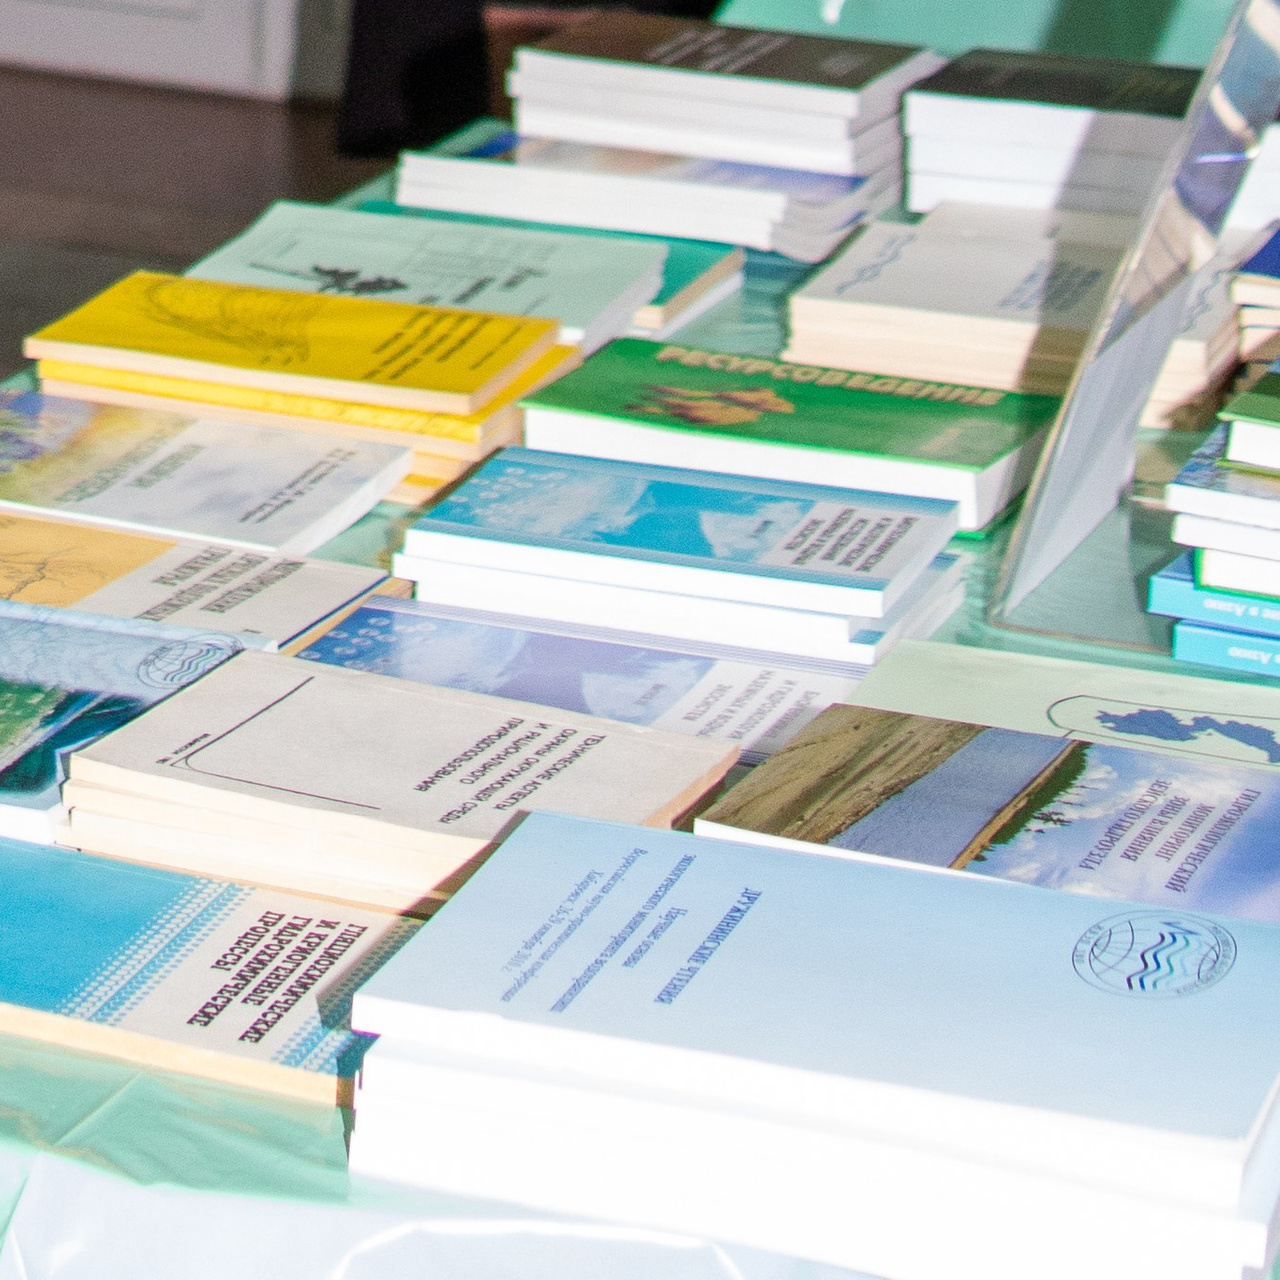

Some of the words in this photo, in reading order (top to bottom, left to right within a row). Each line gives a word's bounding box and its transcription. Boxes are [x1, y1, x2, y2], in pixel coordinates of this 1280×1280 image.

[413, 717, 525, 792] ПРИРОДОПОЛЬЗОВАНИЯ
[457, 730, 542, 785] РАЦИОНАЛЬНОГО
[533, 728, 579, 756] ОХРАНЫ
[534, 734, 606, 780] ТЕХНИЧЕСКИЕ
[470, 756, 540, 802] ОКРУЖАЮЩЕЙ
[492, 780, 545, 811] АСПЕКТЫ
[1121, 780, 1177, 820] ЗЕЙСКОГО
[436, 801, 478, 825] СРЕДЫ
[1154, 795, 1192, 819] ЗОНЫ
[1077, 819, 1136, 870] ГИДРОУЗЛА
[1117, 818, 1170, 861] ВЛИЯНИЯ
[1151, 803, 1216, 862] МОНИТОРИНГ
[1161, 788, 1262, 891] ГИДРОЭКОЛОГИЧЕСКИЙ
[596, 847, 649, 894] Всероссийская
[638, 854, 697, 910] экологического
[210, 910, 286, 971] ПРОЦЕССЫ
[314, 918, 341, 930] И
[643, 907, 689, 940] Научные
[685, 888, 763, 964] ДРУЖИНИНСКИЕ
[186, 915, 313, 1027] ГИДРОХИМИЧЕСКИЕ
[240, 931, 329, 1006] КРИОГЕННЫЕ
[619, 940, 656, 968] основы
[237, 923, 368, 1043] ГЛЯЦИОХИМИЧЕСКИЕ
[651, 965, 700, 1004] ЧТЕНИЯ
